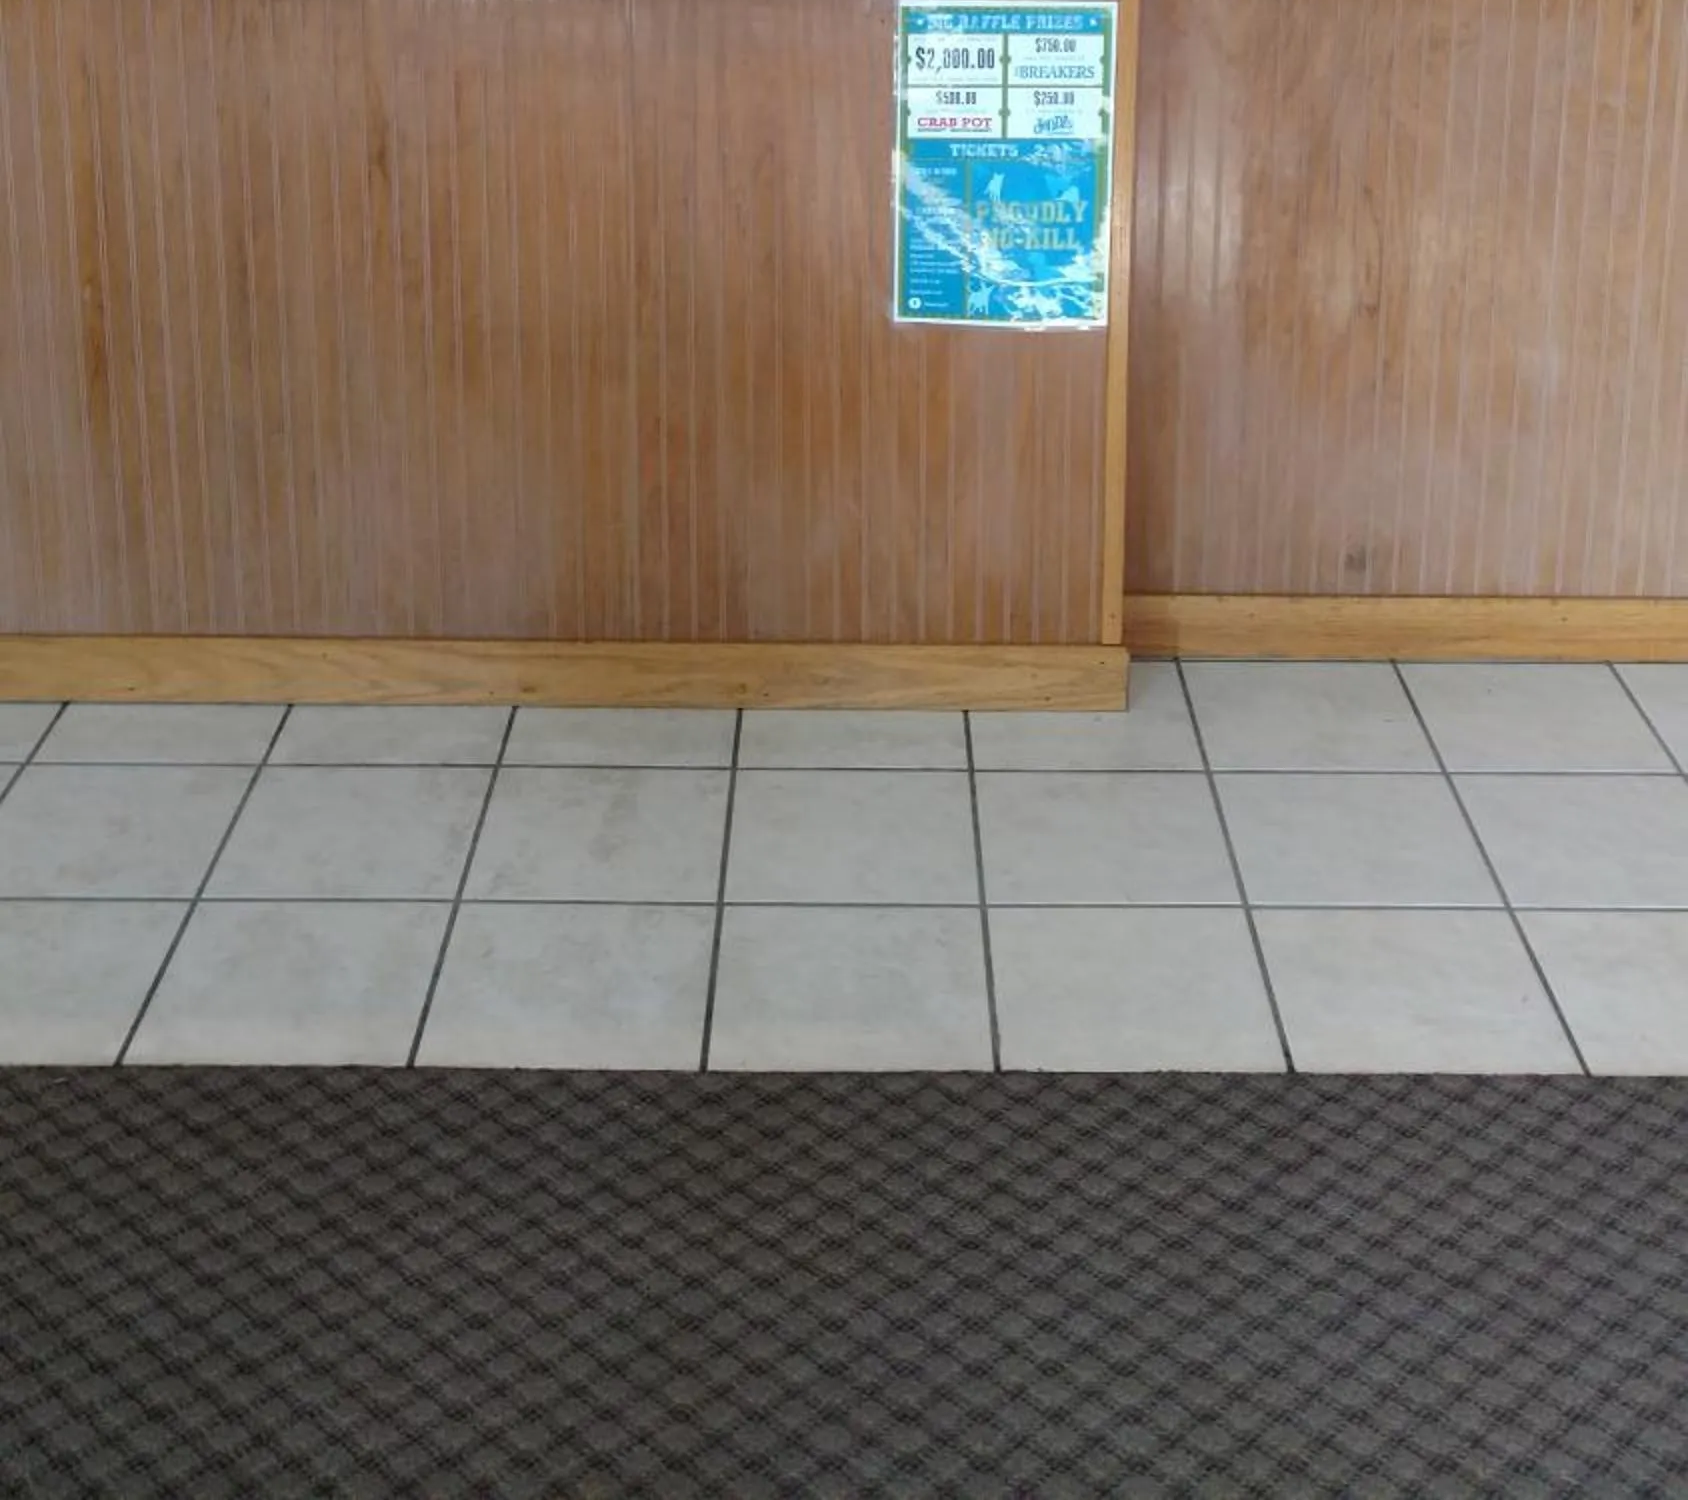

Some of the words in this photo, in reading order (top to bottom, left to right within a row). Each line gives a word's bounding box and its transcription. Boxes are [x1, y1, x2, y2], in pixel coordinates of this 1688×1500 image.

[957, 13, 1020, 30] RAFFLE
[1026, 13, 1084, 30] PRIZES
[1035, 37, 1076, 53] $750.00
[915, 47, 995, 73] $2,000.00
[1020, 65, 1095, 79] BREAKERS
[917, 117, 957, 127] CRAB
[962, 117, 992, 127] POT
[950, 143, 1019, 158] TICKETS
